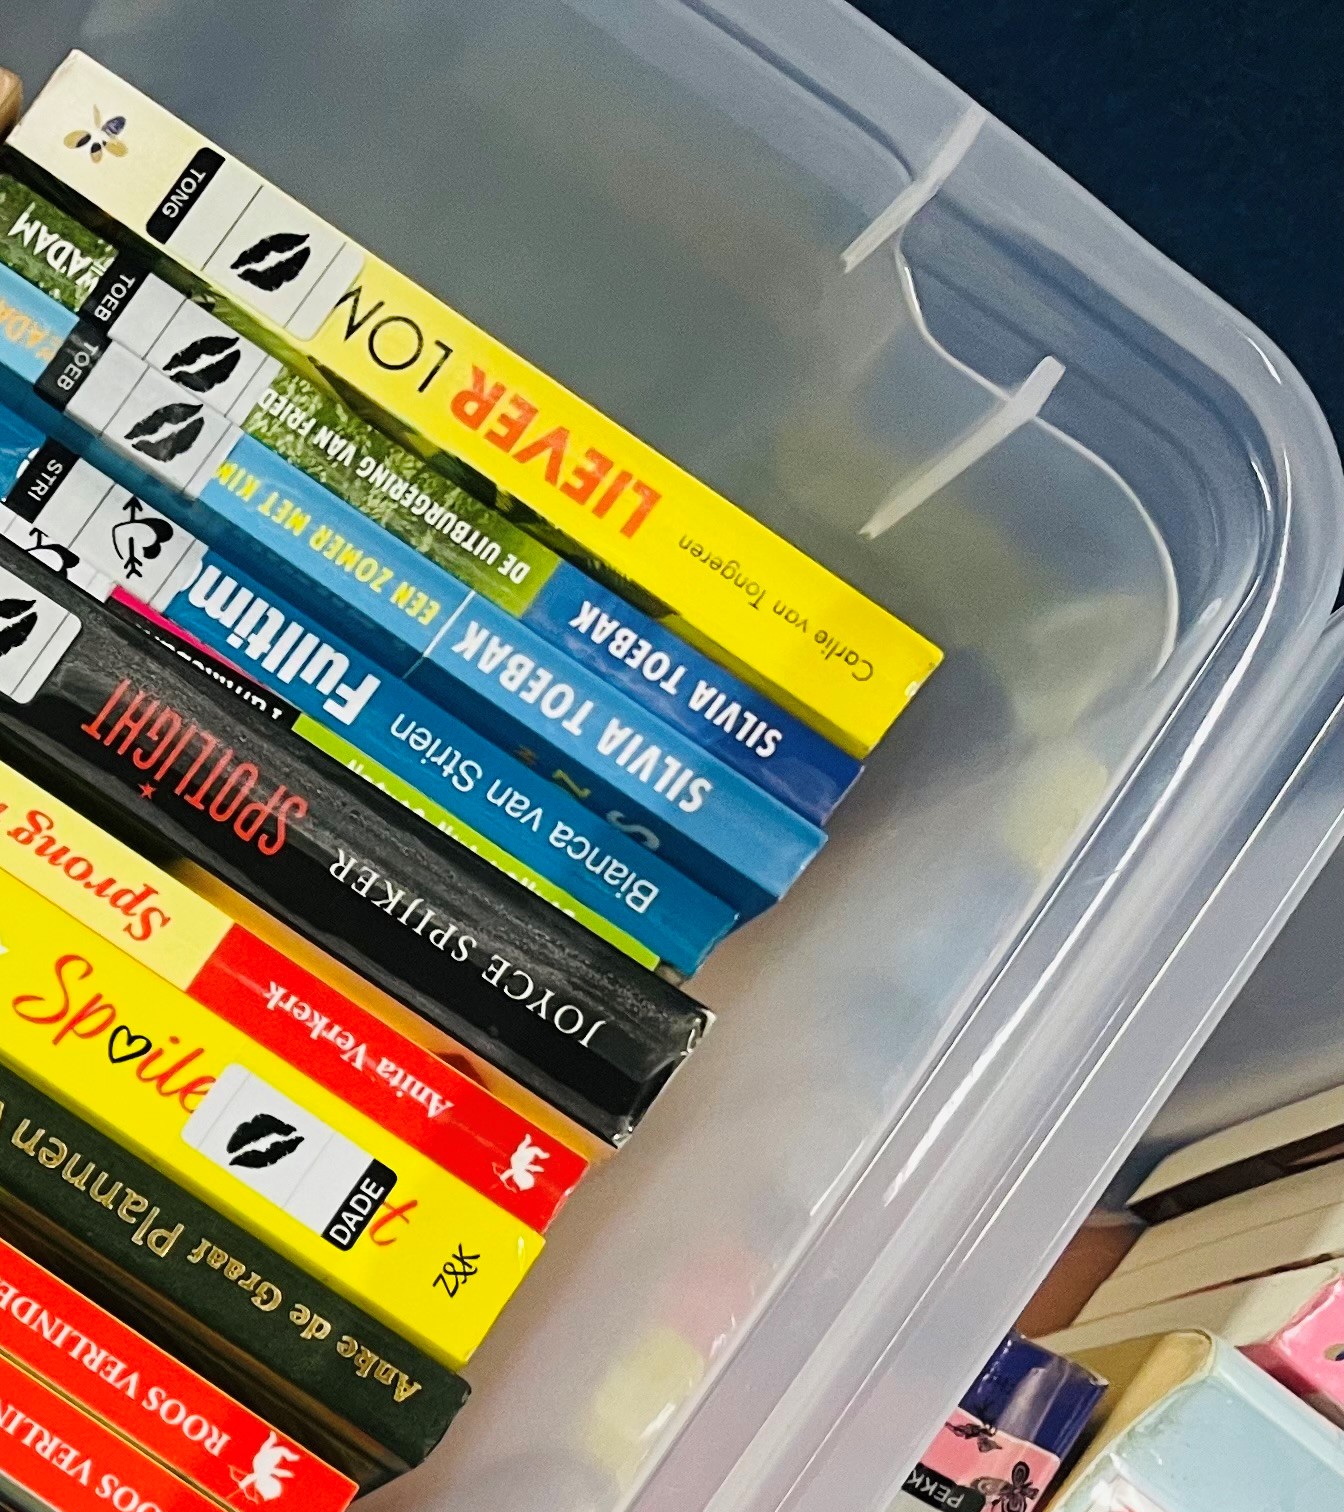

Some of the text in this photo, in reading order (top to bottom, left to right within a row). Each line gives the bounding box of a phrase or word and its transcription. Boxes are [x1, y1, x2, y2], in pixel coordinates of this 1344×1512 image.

[158, 162, 207, 221] TONG
[90, 267, 137, 323] TOEB
[52, 337, 98, 393] TOEB
[25, 454, 65, 501] STRI
[311, 422, 532, 586] DE UITBURGERING VAN
[440, 360, 663, 543] LIEVER
[255, 486, 444, 628] EEN ZOMER MET
[671, 526, 878, 685] Carlie van Tongeren
[448, 615, 600, 739] TOEBAK
[566, 594, 786, 761] SILVIA TOEBAK
[77, 667, 313, 866] SPOTLIGHT
[383, 708, 487, 795] Strien
[481, 775, 548, 835] van
[590, 713, 714, 817] SILVIA
[541, 817, 661, 916] Bianca
[323, 840, 608, 1051] JOYCE SPIJKER
[255, 975, 456, 1125] Anita Verkerk
[0, 1110, 187, 1261] Plannen
[325, 1172, 387, 1247] DADE
[183, 1231, 424, 1409] Anke de Graaf
[430, 1239, 486, 1301] Z&K
[138, 1380, 232, 1458] ROOS
